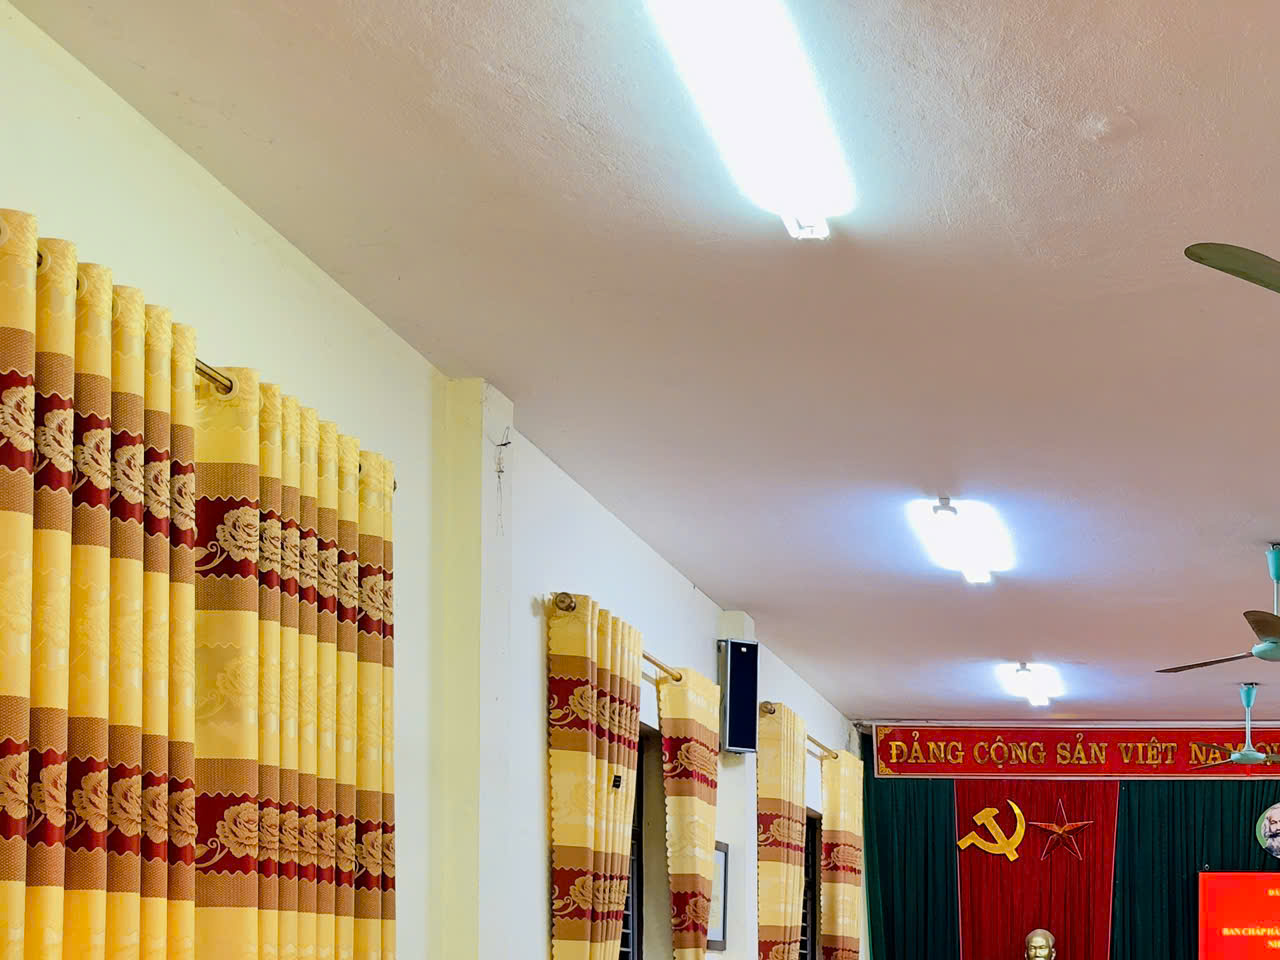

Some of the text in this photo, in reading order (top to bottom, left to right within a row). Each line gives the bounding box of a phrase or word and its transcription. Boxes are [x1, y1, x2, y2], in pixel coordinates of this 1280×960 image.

[889, 731, 965, 764] ĐẢNG
[973, 735, 1047, 768] CỘNG
[1056, 732, 1108, 765] SẢN
[1117, 736, 1178, 768] VIỆT
[1222, 927, 1241, 937] BAN
